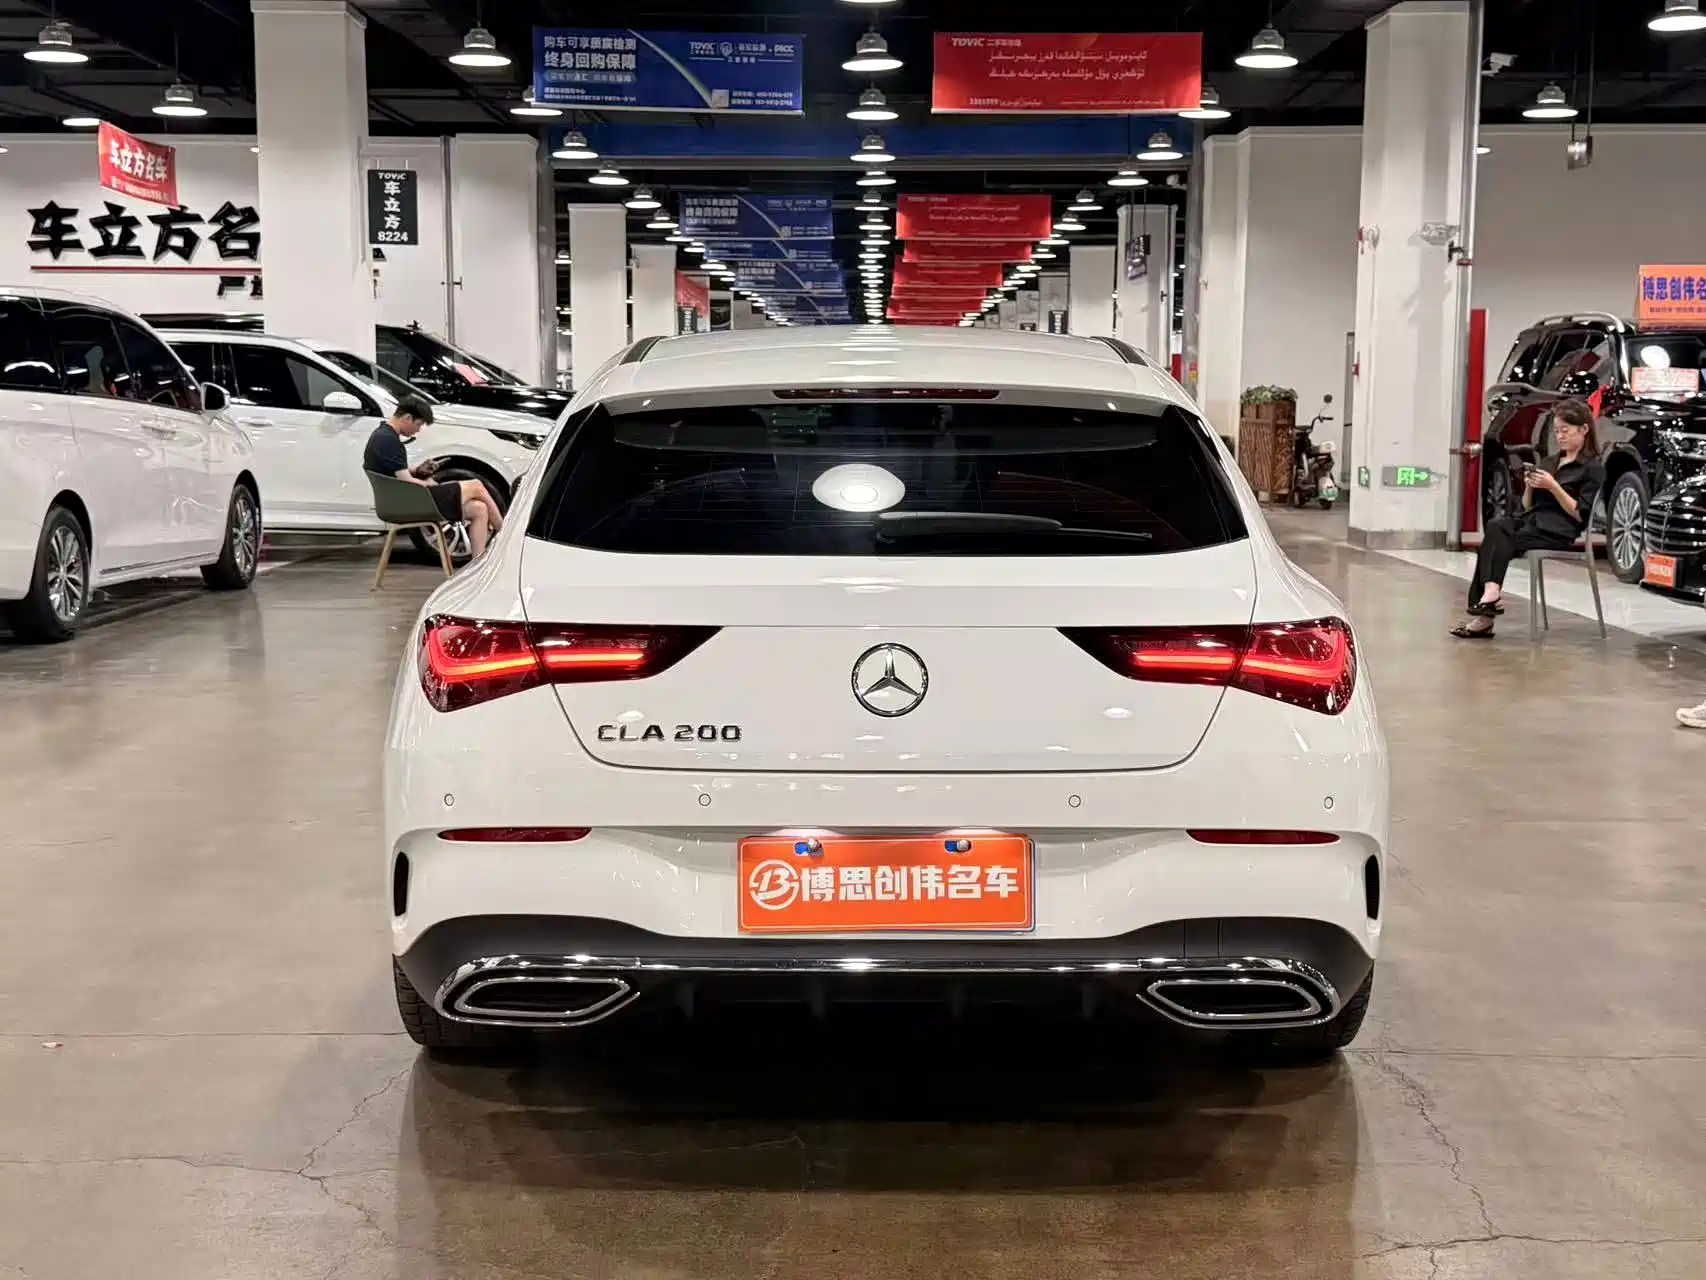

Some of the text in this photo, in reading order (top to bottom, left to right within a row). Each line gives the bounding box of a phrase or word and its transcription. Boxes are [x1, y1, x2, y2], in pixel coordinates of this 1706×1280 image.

[952, 37, 985, 47] TOVIC
[544, 51, 637, 70] 终身回购保障
[110, 138, 168, 182] 车立方名车
[378, 172, 407, 180] TOVIC
[384, 181, 401, 230] 车立方
[27, 200, 260, 262] 车立方名
[378, 231, 408, 242] 8224
[598, 724, 741, 742] CLA 200
[801, 865, 1019, 901] 博思创伟名车
